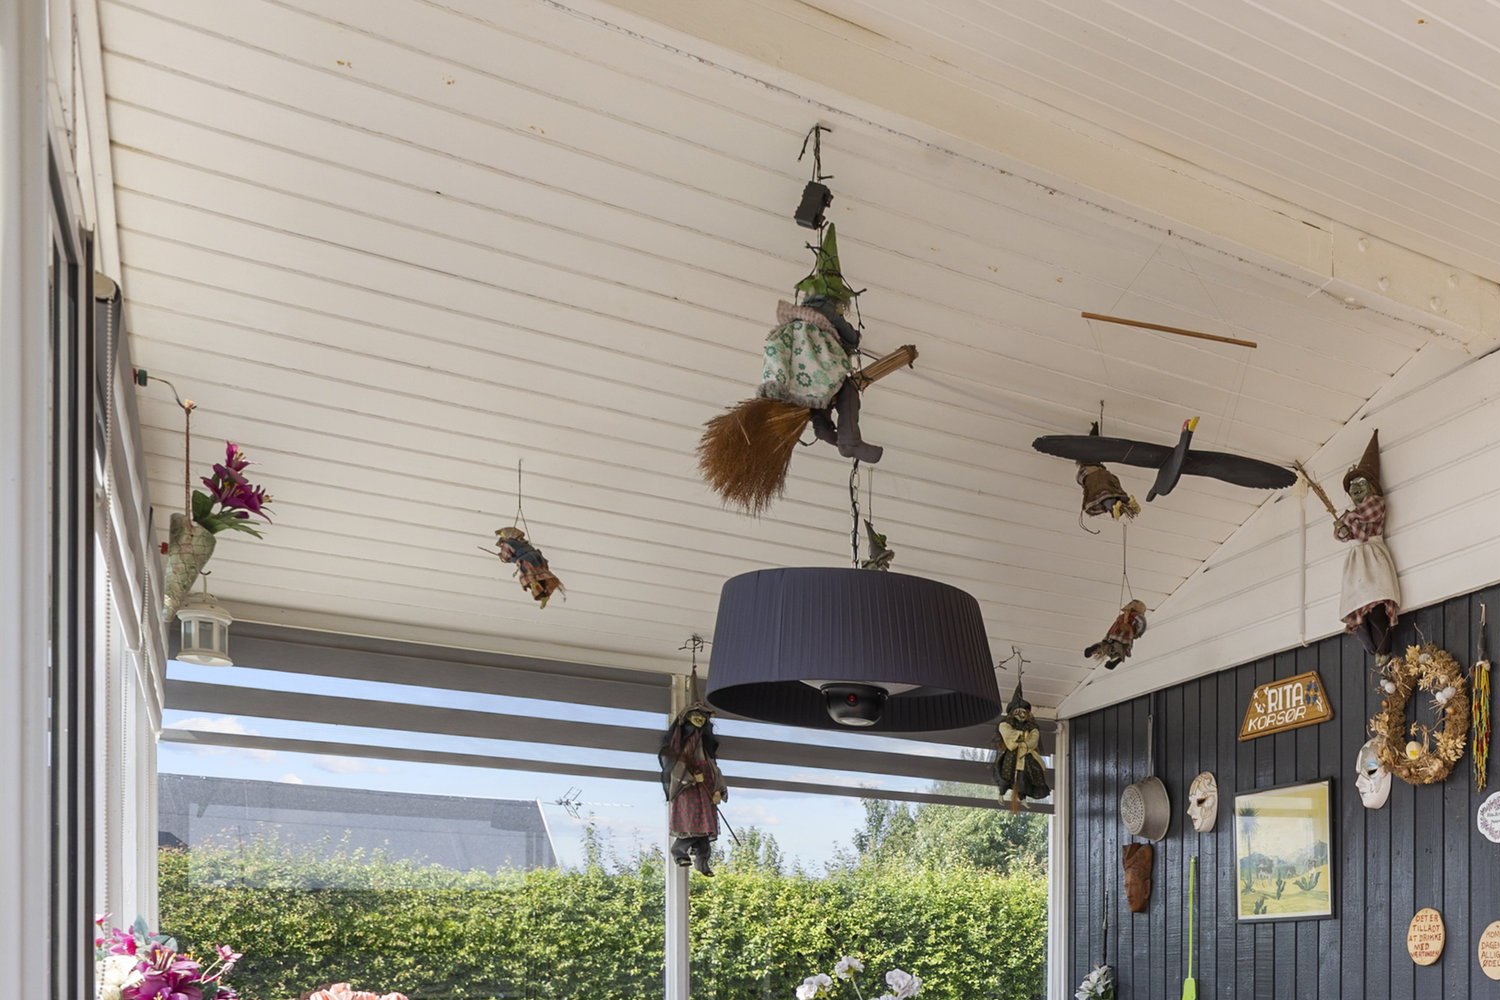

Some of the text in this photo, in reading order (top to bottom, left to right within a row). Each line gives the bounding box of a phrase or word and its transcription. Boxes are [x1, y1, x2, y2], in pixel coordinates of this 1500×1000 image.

[1267, 682, 1304, 714] RITA
[1247, 705, 1307, 732] KORSØR
[1415, 913, 1439, 923] DET ER
[1412, 924, 1440, 933] TILLADT
[1408, 932, 1441, 942] AT DRIKKE
[1485, 930, 1500, 938] KOM
[1414, 942, 1430, 951] MED
